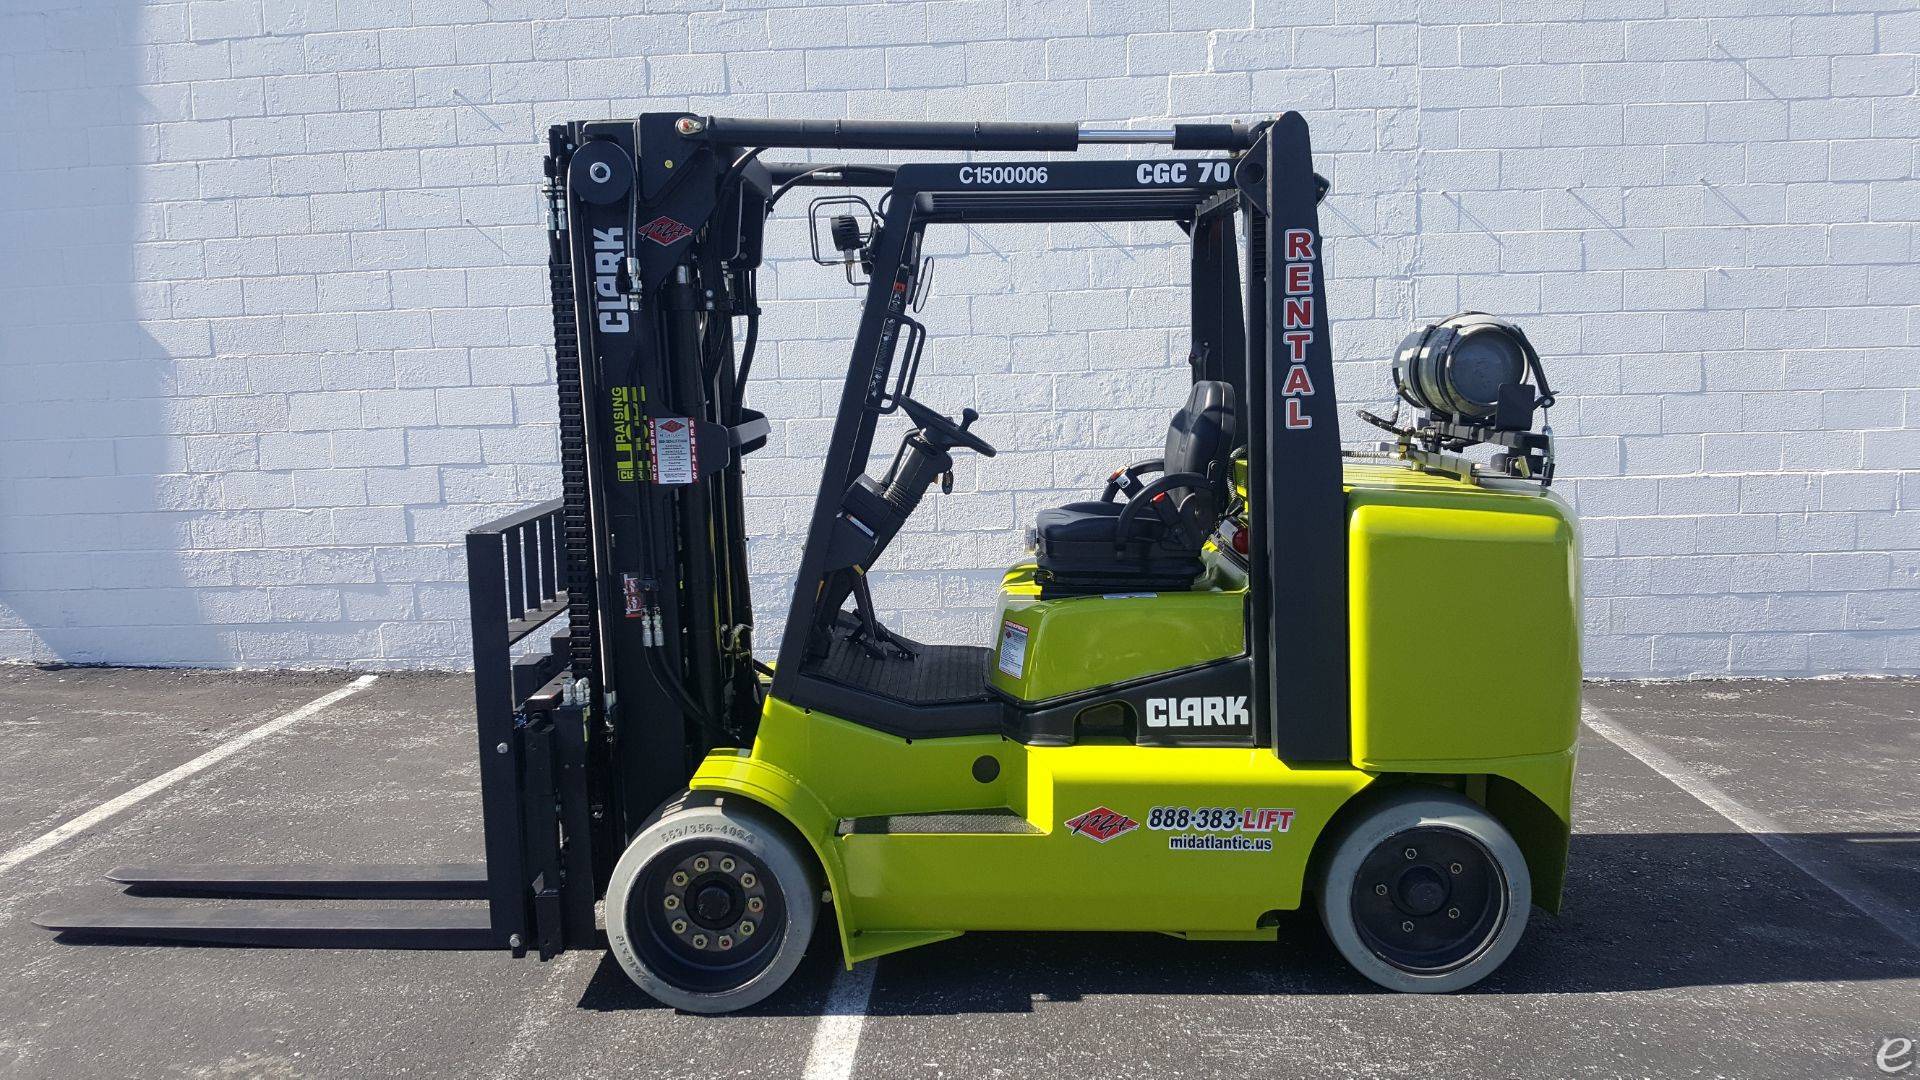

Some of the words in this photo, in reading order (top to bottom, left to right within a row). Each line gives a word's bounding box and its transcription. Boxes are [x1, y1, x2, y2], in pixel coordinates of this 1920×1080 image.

[959, 166, 1048, 184] C1500006
[1136, 163, 1187, 184] CGC
[1198, 162, 1231, 183] 70
[593, 227, 629, 333] CLARK
[1283, 229, 1314, 429] RENTAL
[612, 387, 624, 443] RAISING
[649, 421, 658, 481] SERVICE
[689, 420, 698, 480] RENTALS
[1146, 696, 1249, 728] CLARK
[1169, 834, 1272, 851] midatlantic.us
